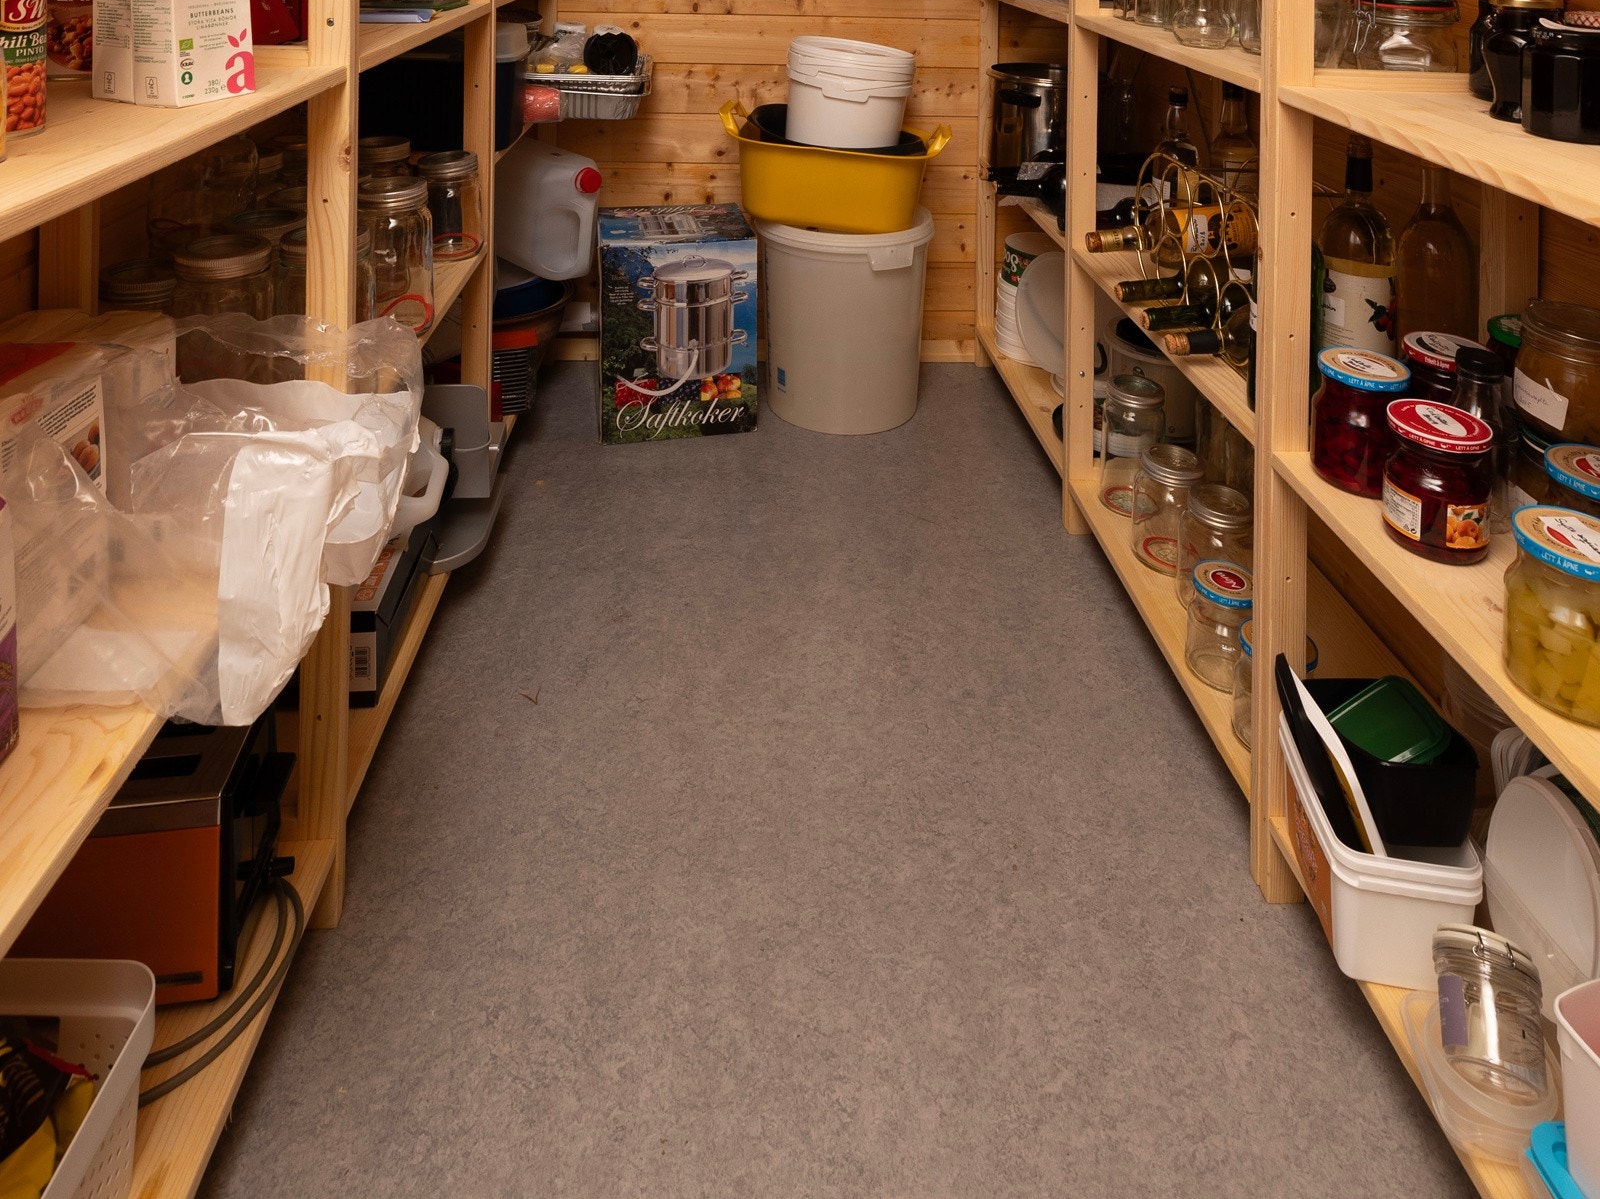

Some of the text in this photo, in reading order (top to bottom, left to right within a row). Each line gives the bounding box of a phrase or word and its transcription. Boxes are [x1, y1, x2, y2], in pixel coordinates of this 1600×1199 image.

[190, 8, 234, 19] BUTTERBEANS
[0, 34, 28, 48] hili
[16, 46, 44, 57] PINTO
[1348, 377, 1360, 386] LETT
[616, 394, 746, 440] Saftkoker
[1541, 551, 1556, 562] LETT
